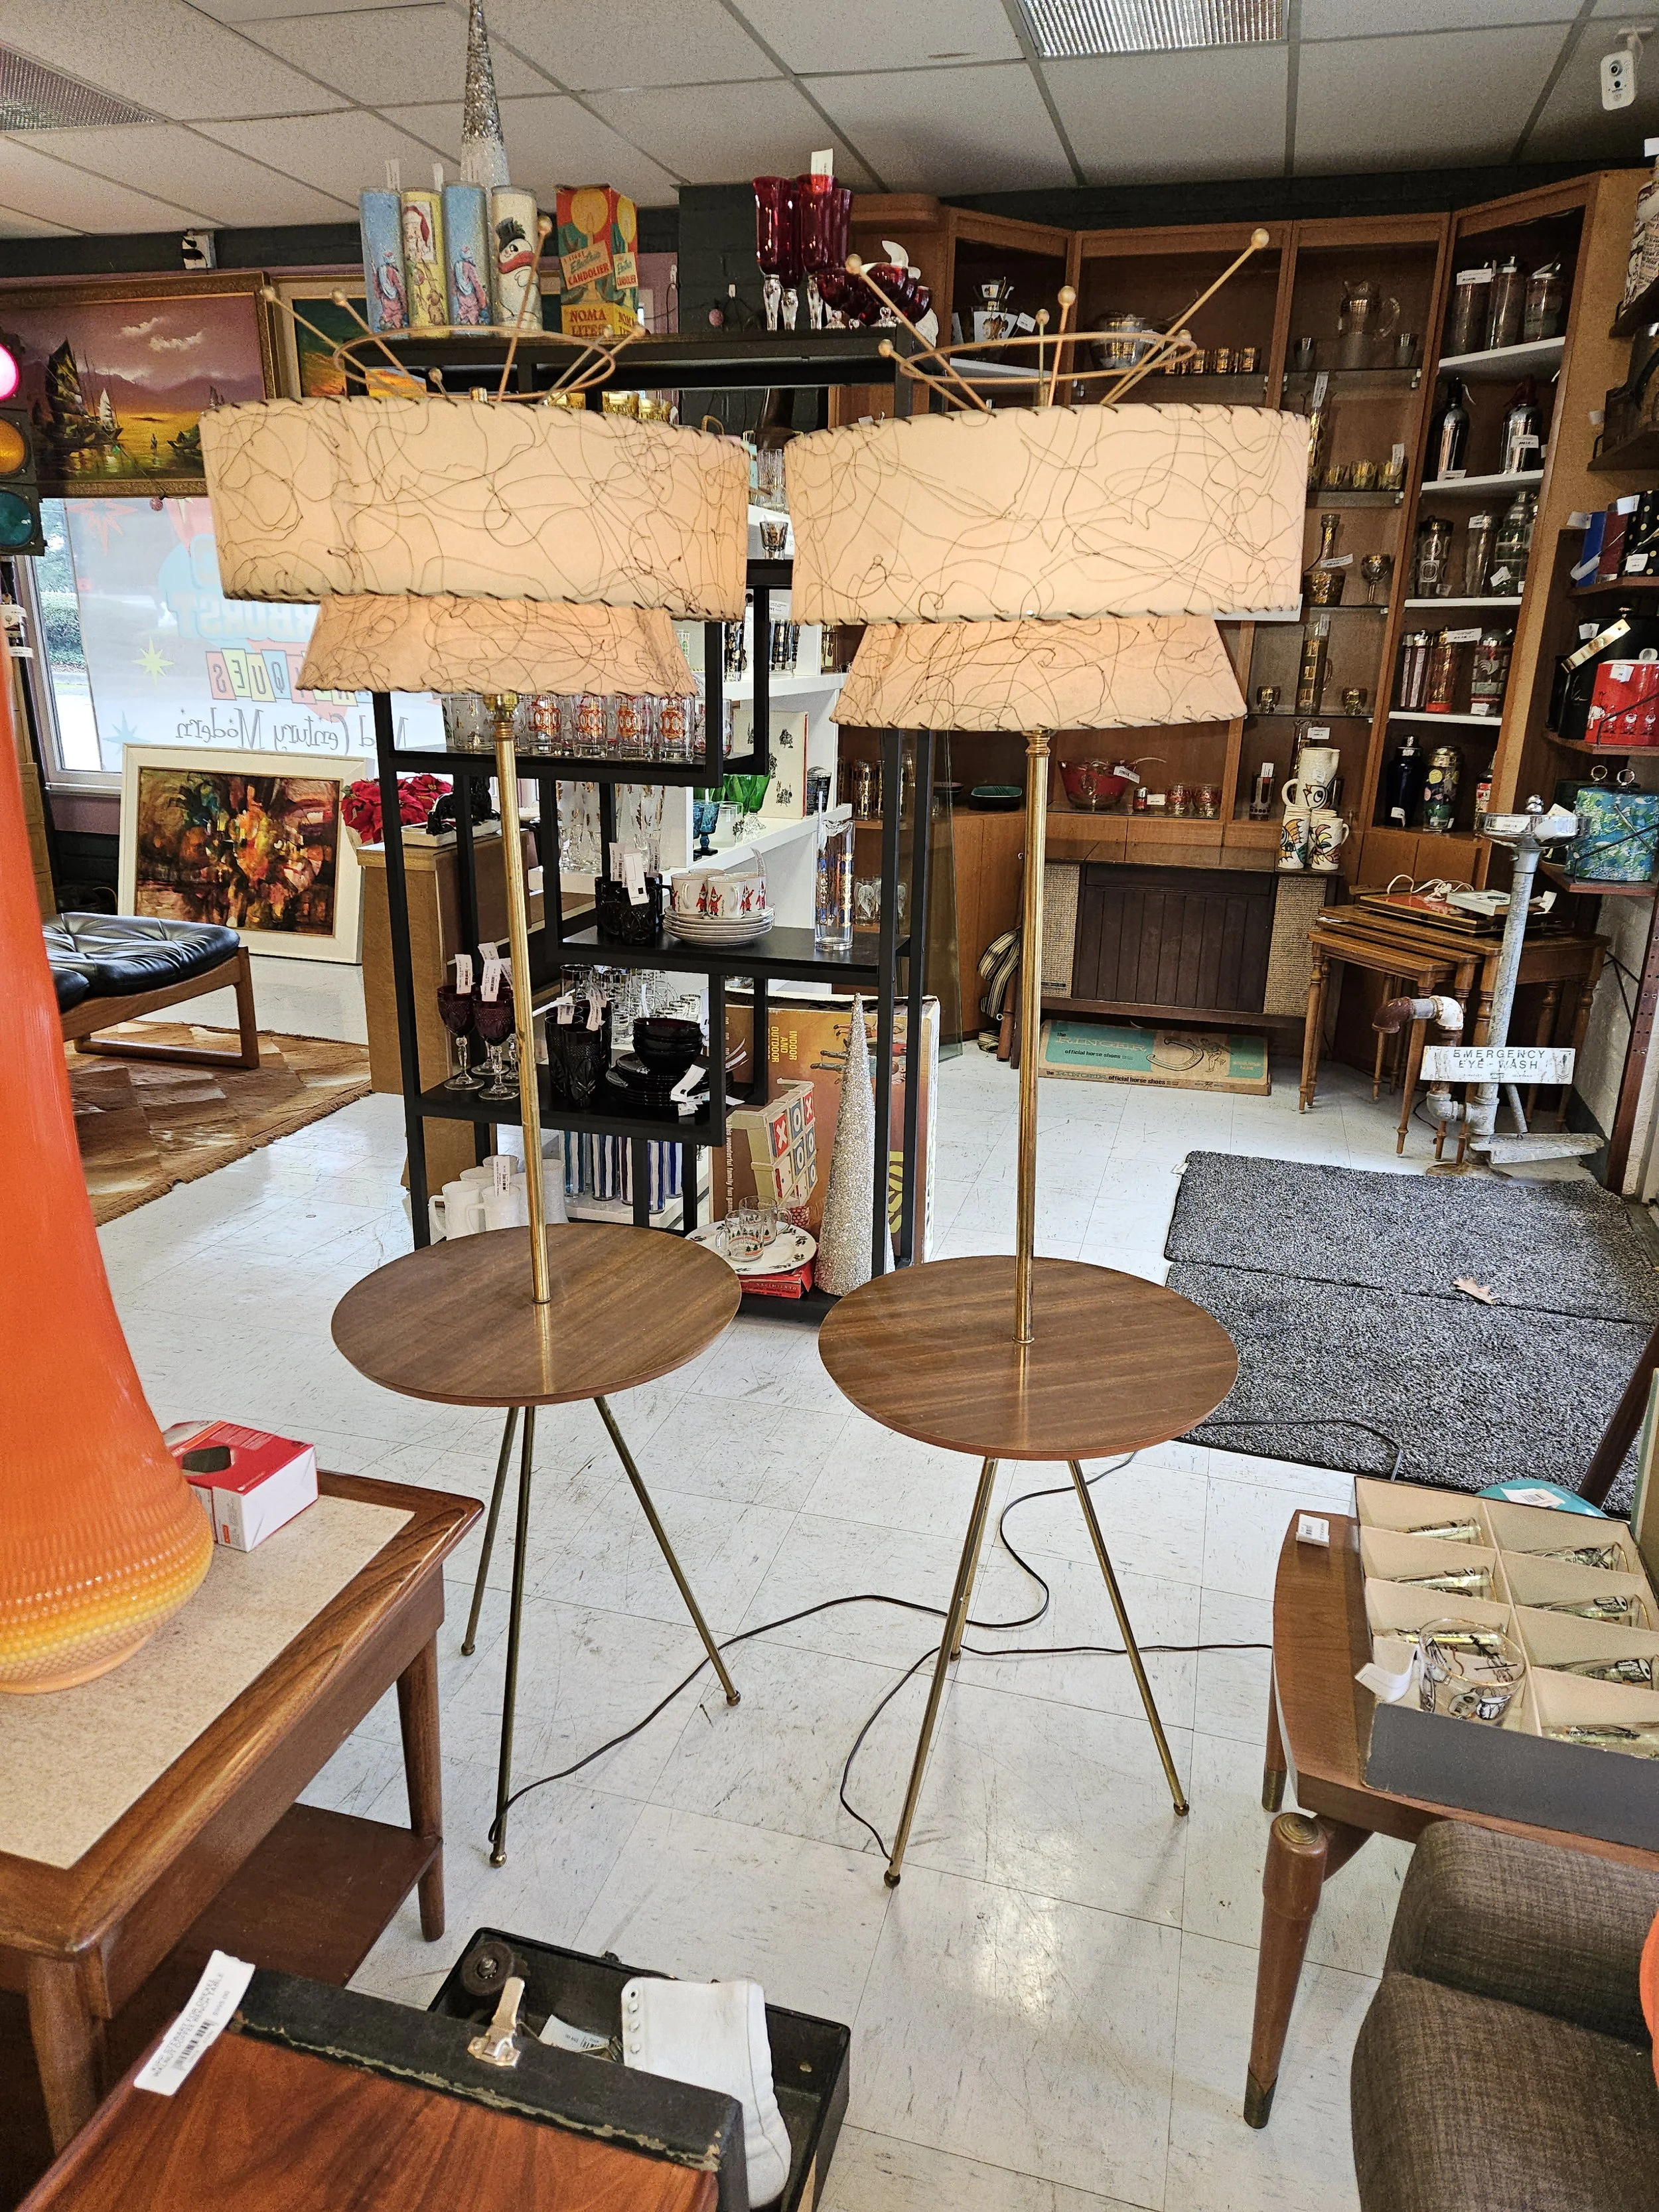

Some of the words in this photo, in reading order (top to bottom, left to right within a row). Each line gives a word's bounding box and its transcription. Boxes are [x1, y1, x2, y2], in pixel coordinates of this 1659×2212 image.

[568, 262, 610, 285] CANDOLIER
[569, 308, 607, 323] NOMA
[770, 1026, 780, 1063] OUTDOOR
[780, 1037, 788, 1054] AND
[789, 1031, 798, 1061] INDOOR
[1055, 1036, 1147, 1052] RINGER
[1453, 1049, 1546, 1059] EMERGENCY
